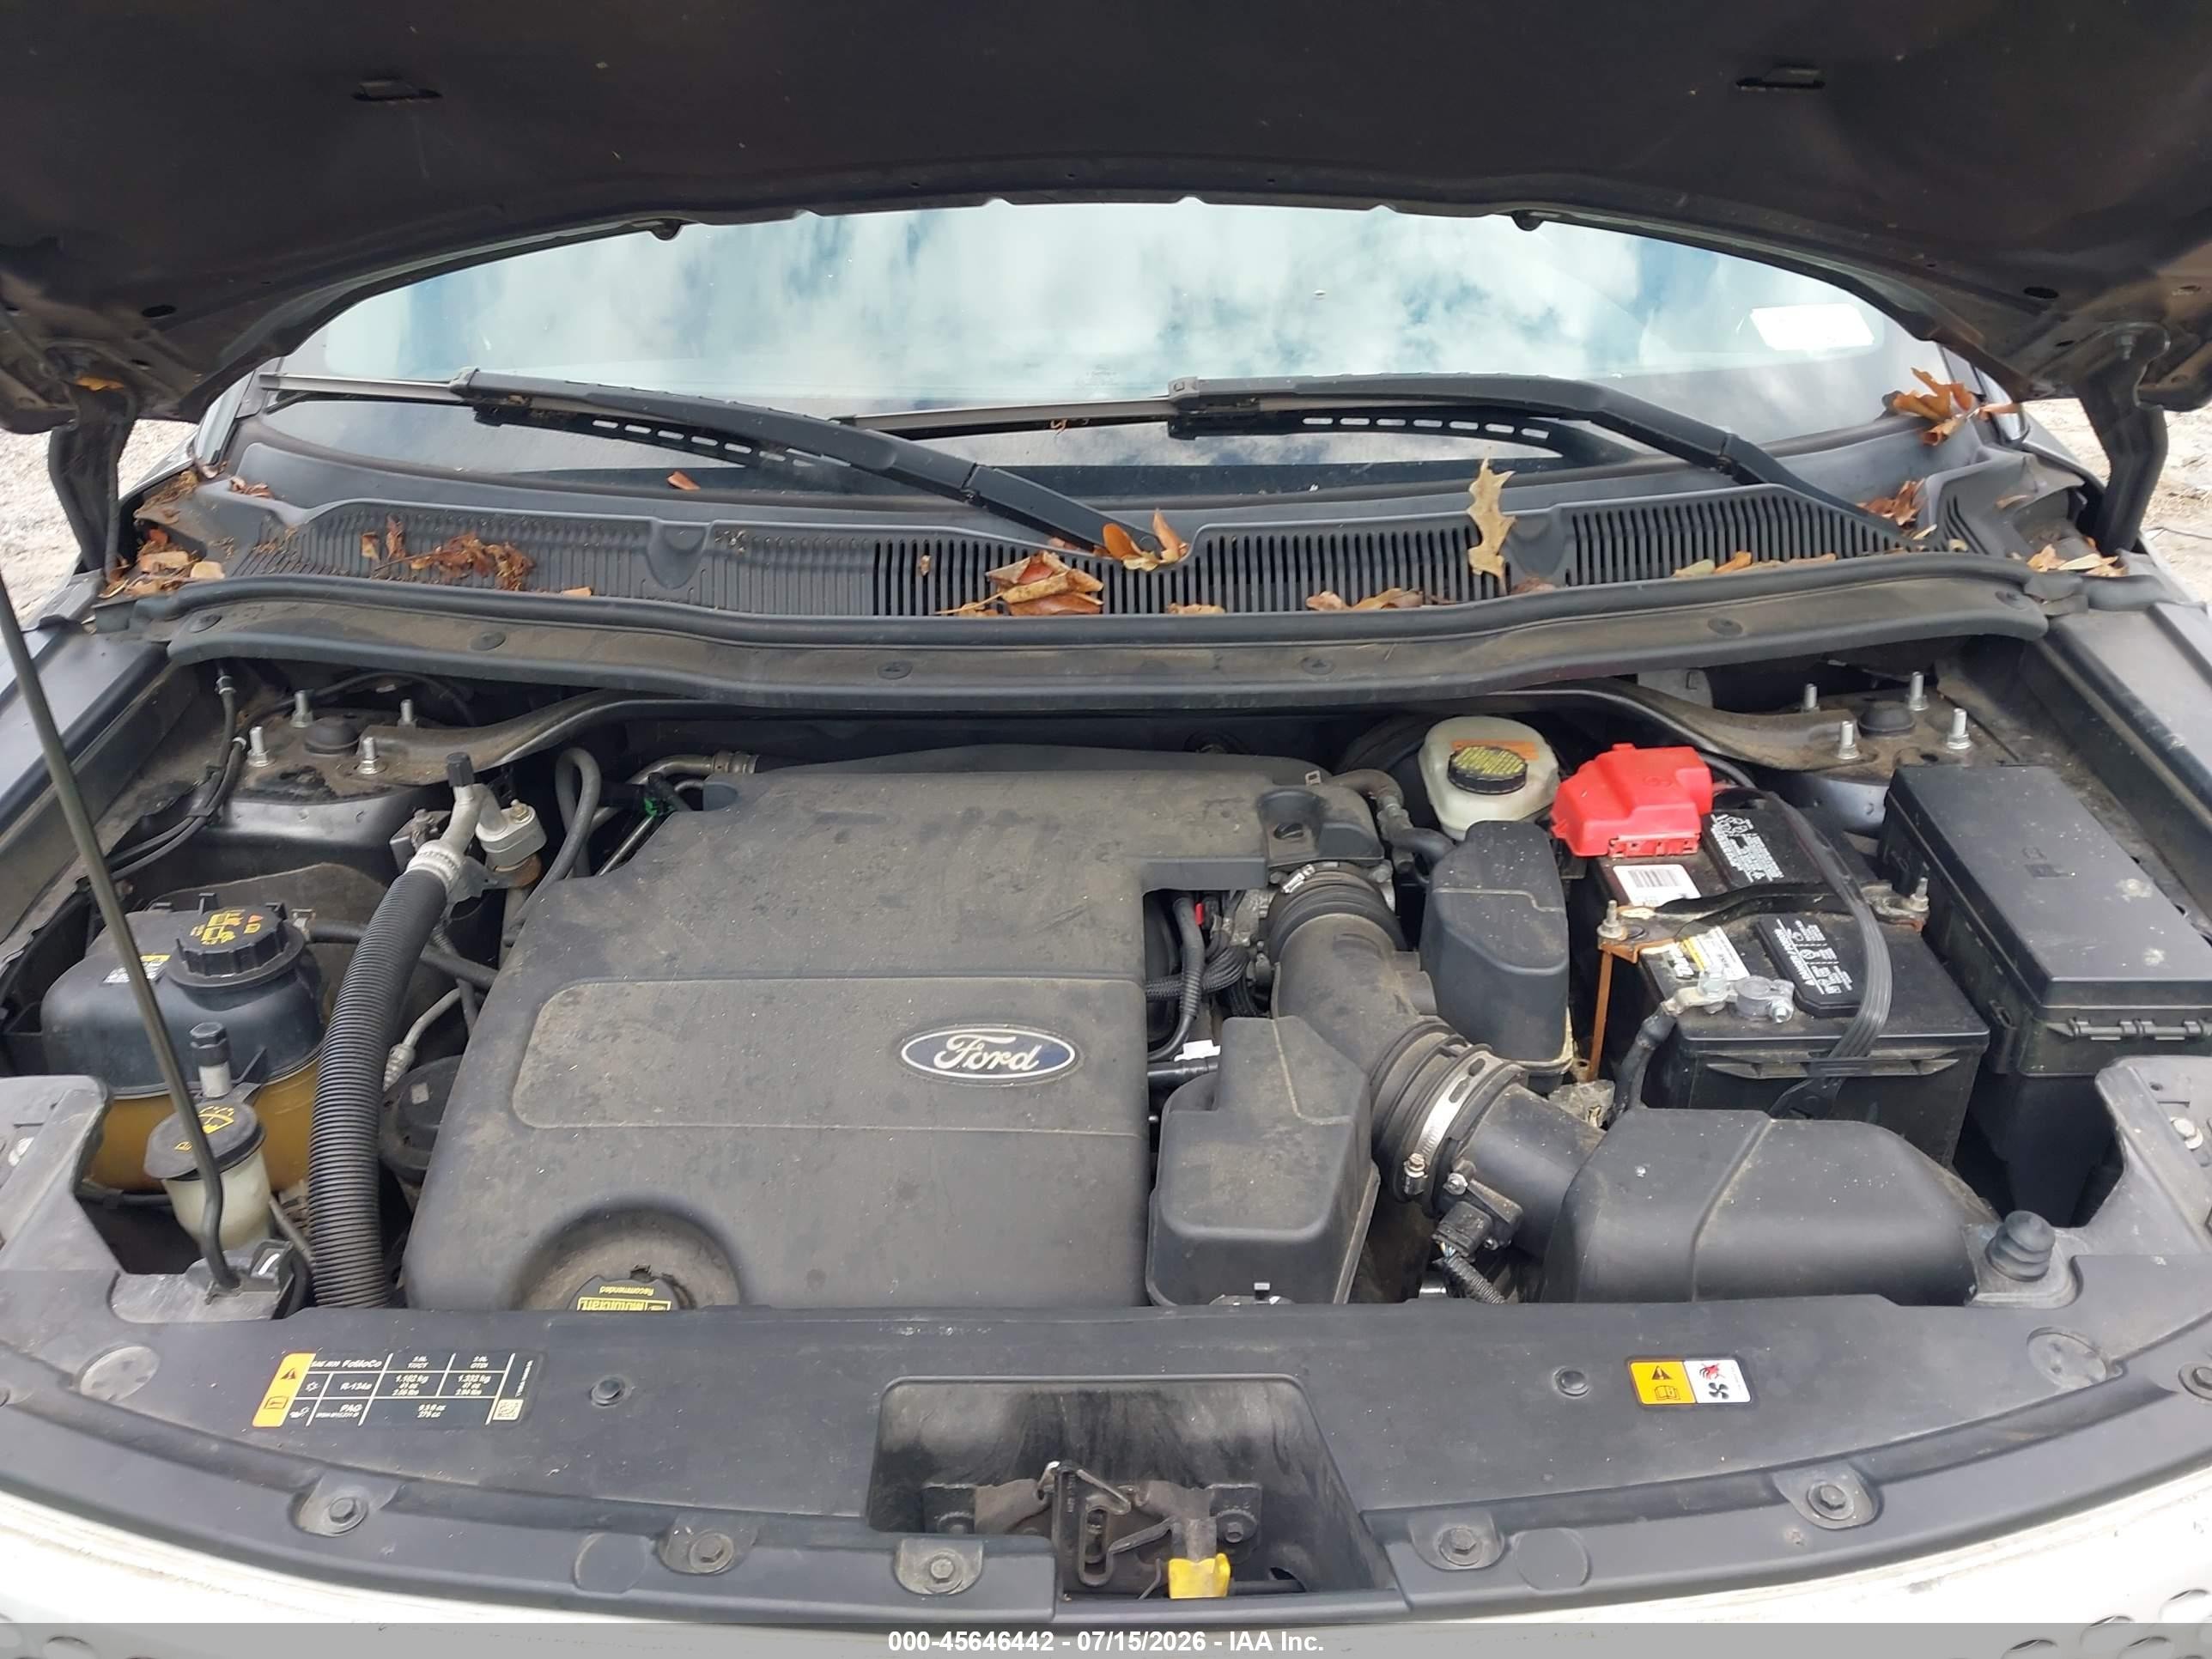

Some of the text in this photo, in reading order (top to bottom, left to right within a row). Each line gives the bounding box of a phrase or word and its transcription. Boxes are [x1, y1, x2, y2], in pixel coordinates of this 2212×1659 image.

[933, 1034, 1042, 1071] Ford
[599, 1285, 654, 1297] Recommended
[338, 1404, 363, 1413] PAG
